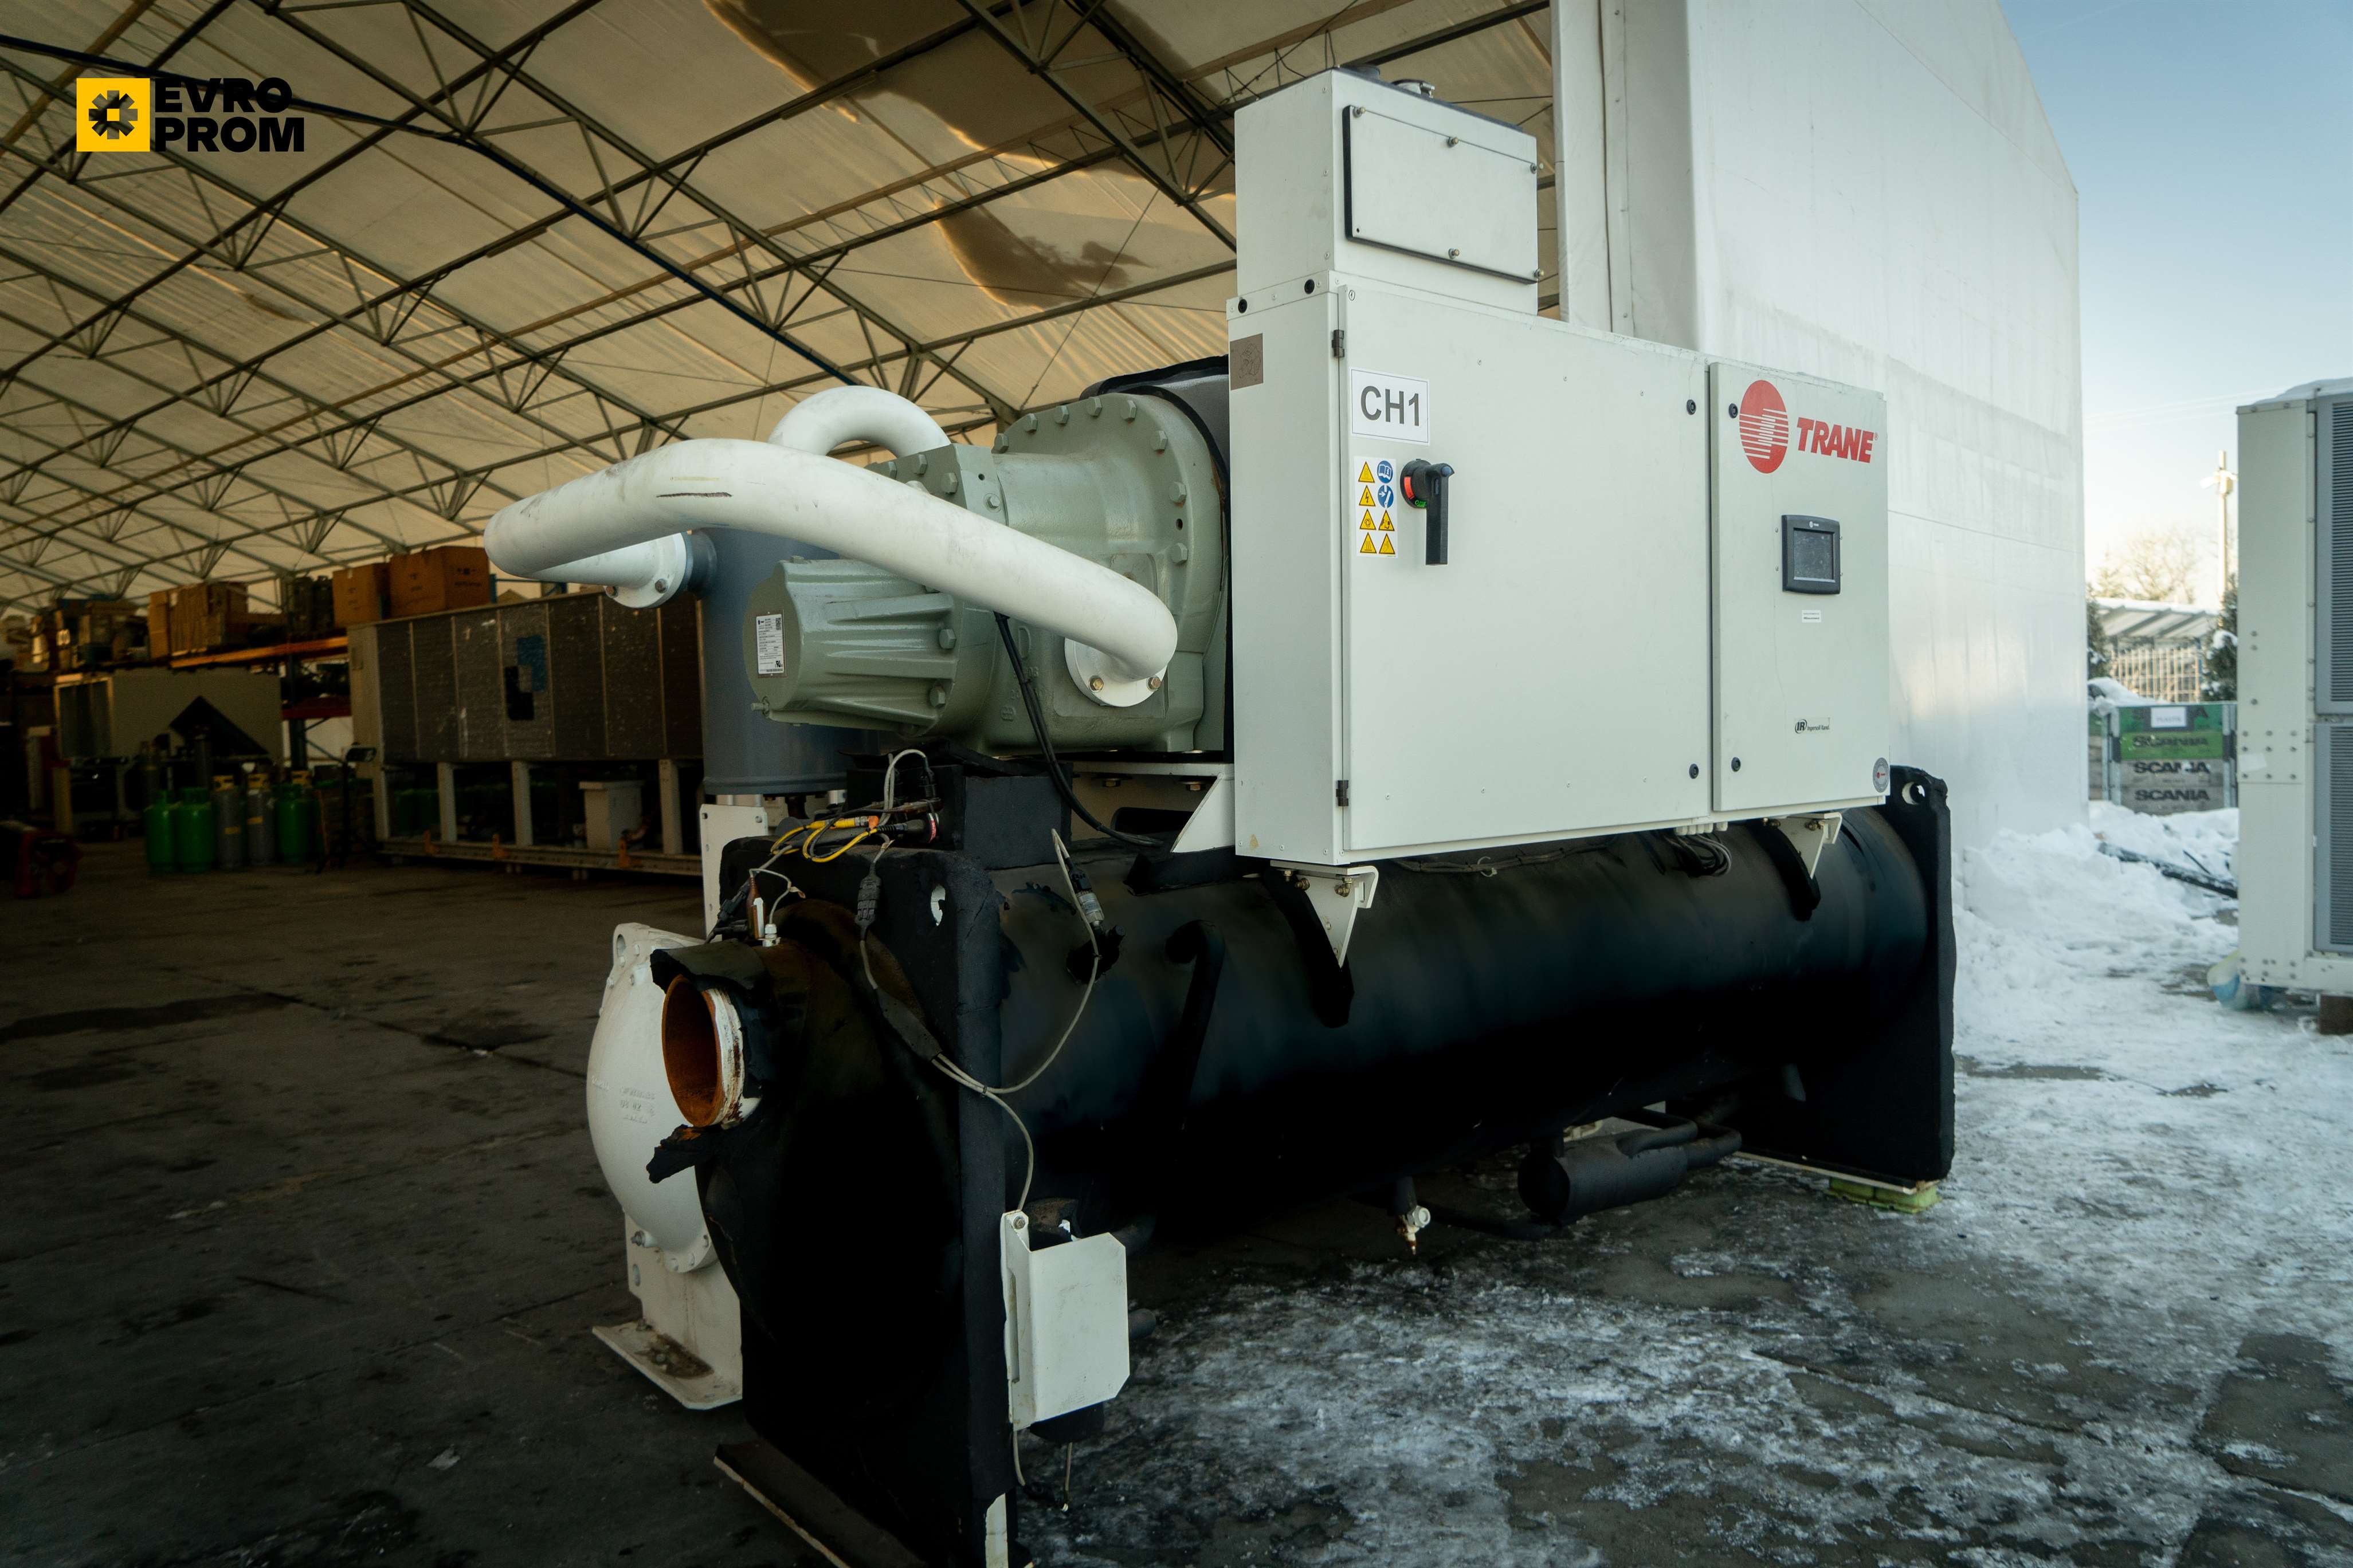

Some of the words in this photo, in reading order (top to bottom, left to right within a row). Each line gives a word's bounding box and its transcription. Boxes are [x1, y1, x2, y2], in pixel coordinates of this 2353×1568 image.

[1360, 386, 1419, 426] CH1
[1797, 417, 1874, 463] TRANE
[2135, 789, 2210, 801] SCANIA
